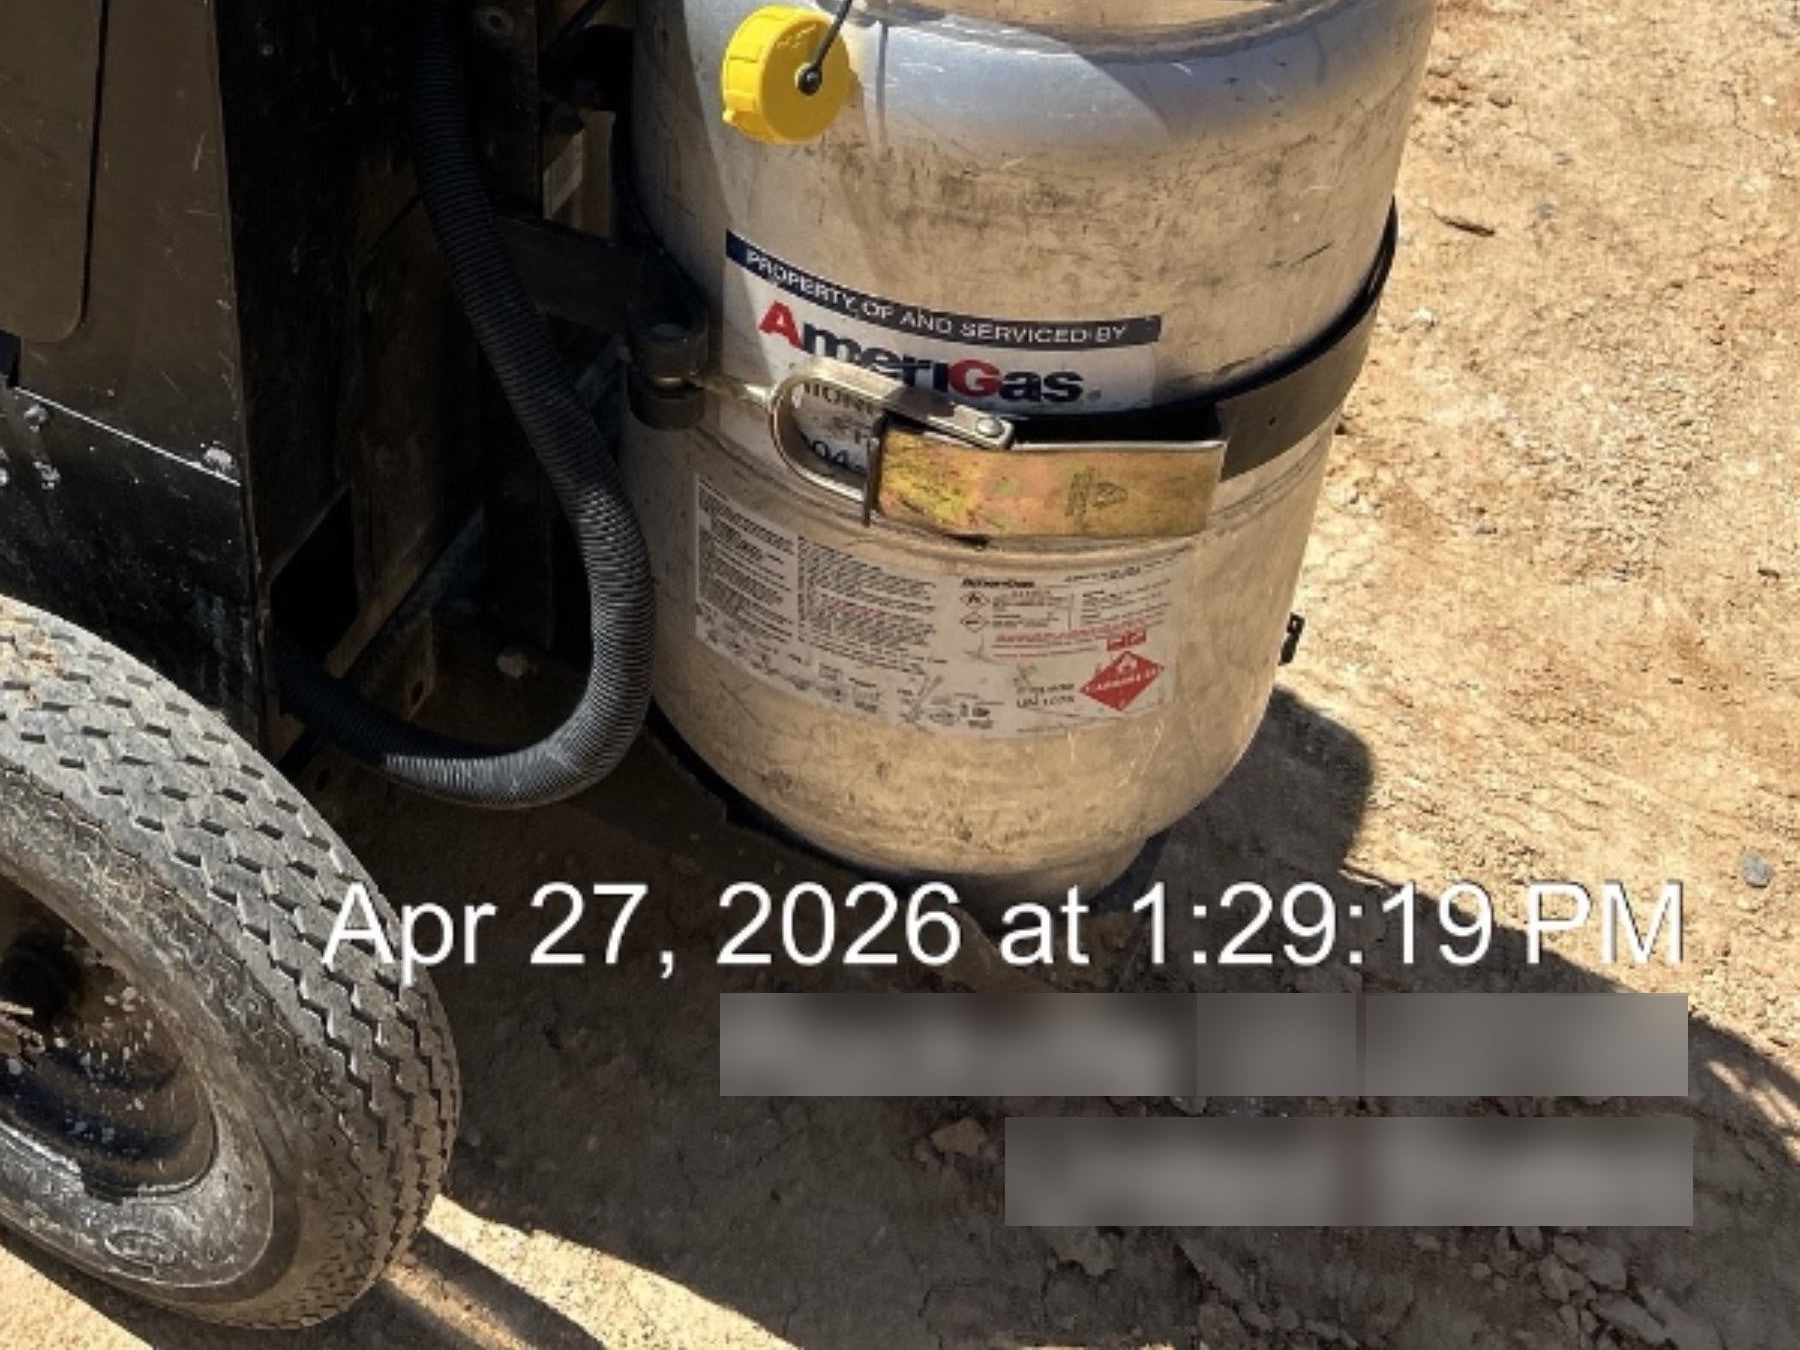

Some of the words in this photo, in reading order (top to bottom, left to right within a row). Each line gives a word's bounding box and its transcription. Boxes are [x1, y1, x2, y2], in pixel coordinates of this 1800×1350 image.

[746, 250, 857, 312] PROPERTY
[862, 302, 895, 319] OF
[899, 310, 952, 334] AND
[960, 322, 1088, 344] SERVICED
[1095, 326, 1129, 343] BY
[758, 300, 1084, 402] AmeriGas
